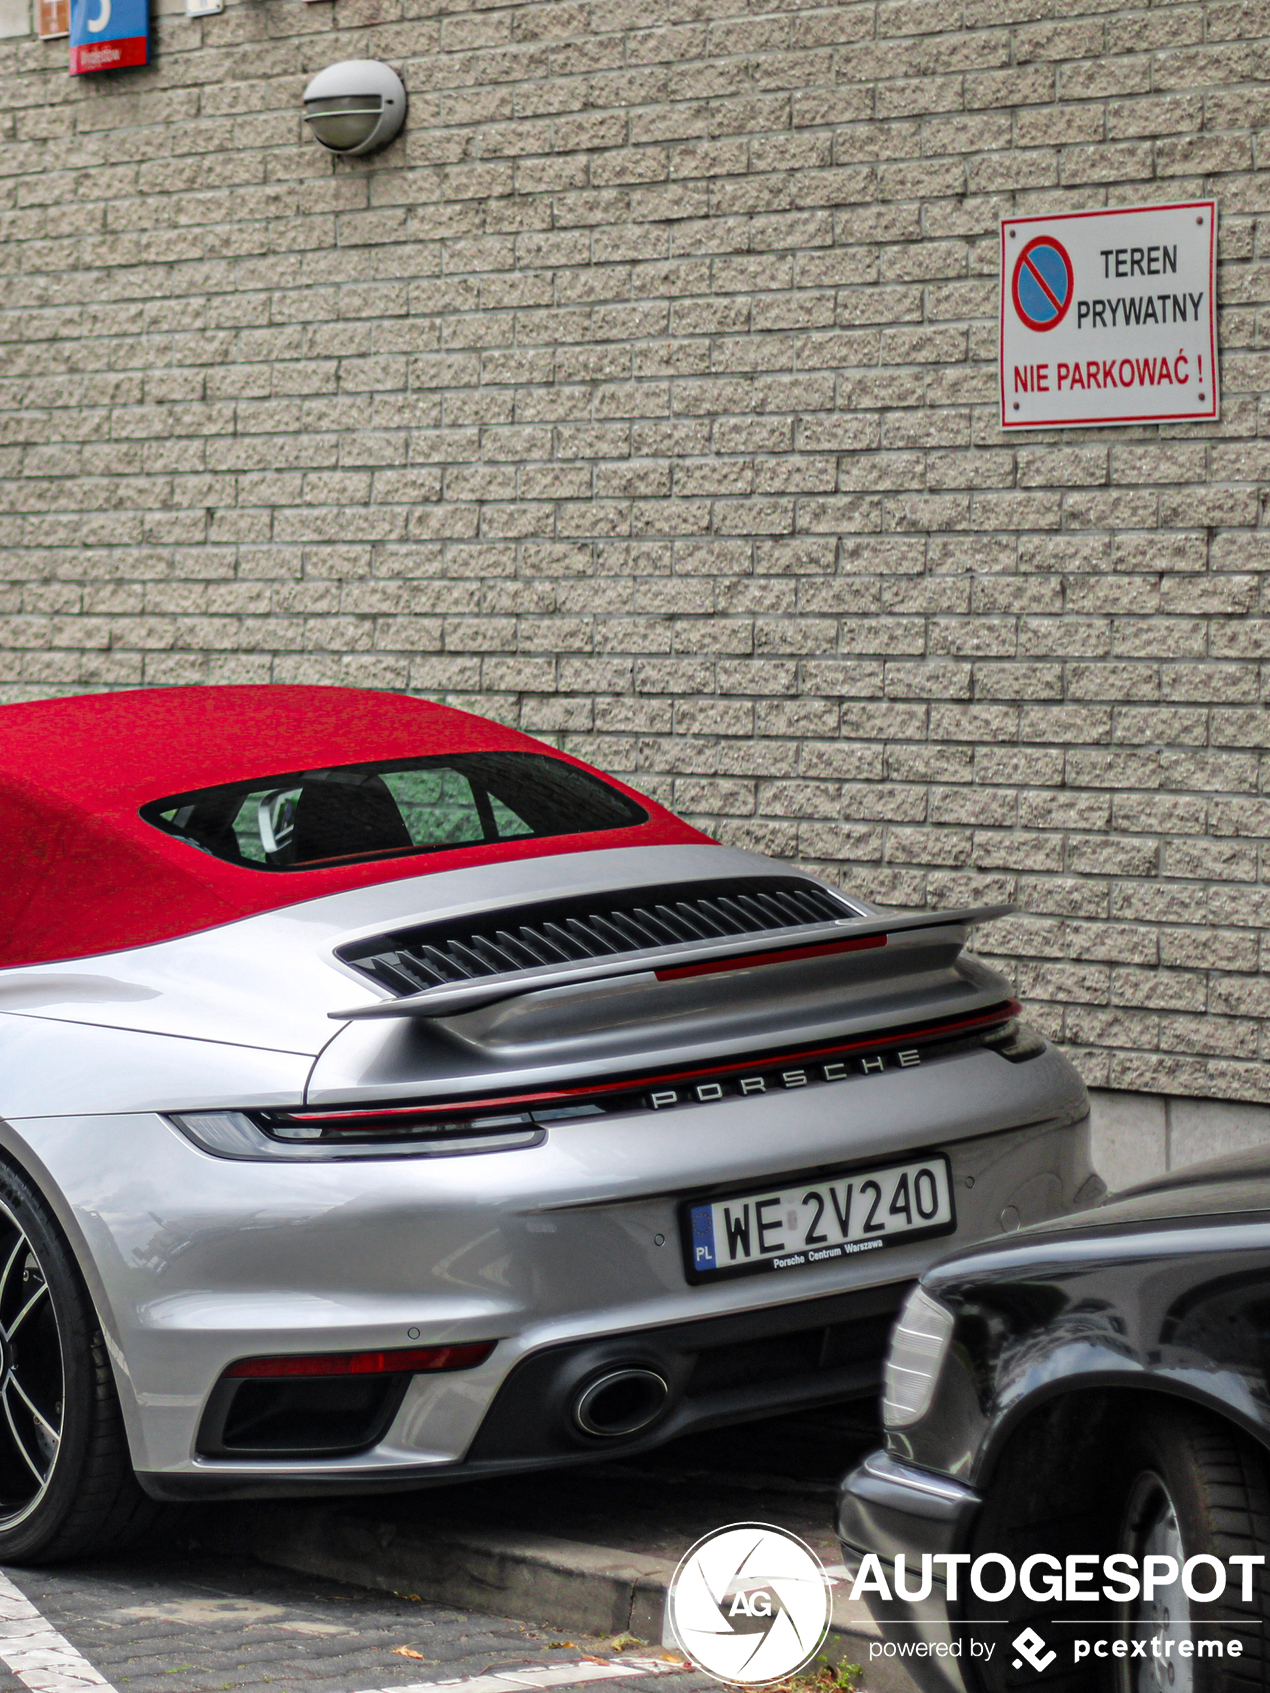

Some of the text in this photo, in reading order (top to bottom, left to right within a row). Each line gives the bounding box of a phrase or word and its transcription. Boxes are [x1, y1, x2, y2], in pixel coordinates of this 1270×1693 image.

[1100, 244, 1178, 279] TEREN
[1077, 292, 1204, 330] PRYWATNY
[1013, 363, 1050, 394] NIE
[1057, 348, 1190, 391] PARKOWAĆ
[650, 1048, 922, 1110] PORSCHE
[724, 1168, 940, 1261] WE 2V240
[696, 1247, 713, 1262] PL
[773, 1239, 883, 1269] Porsche Centrum Warszawa
